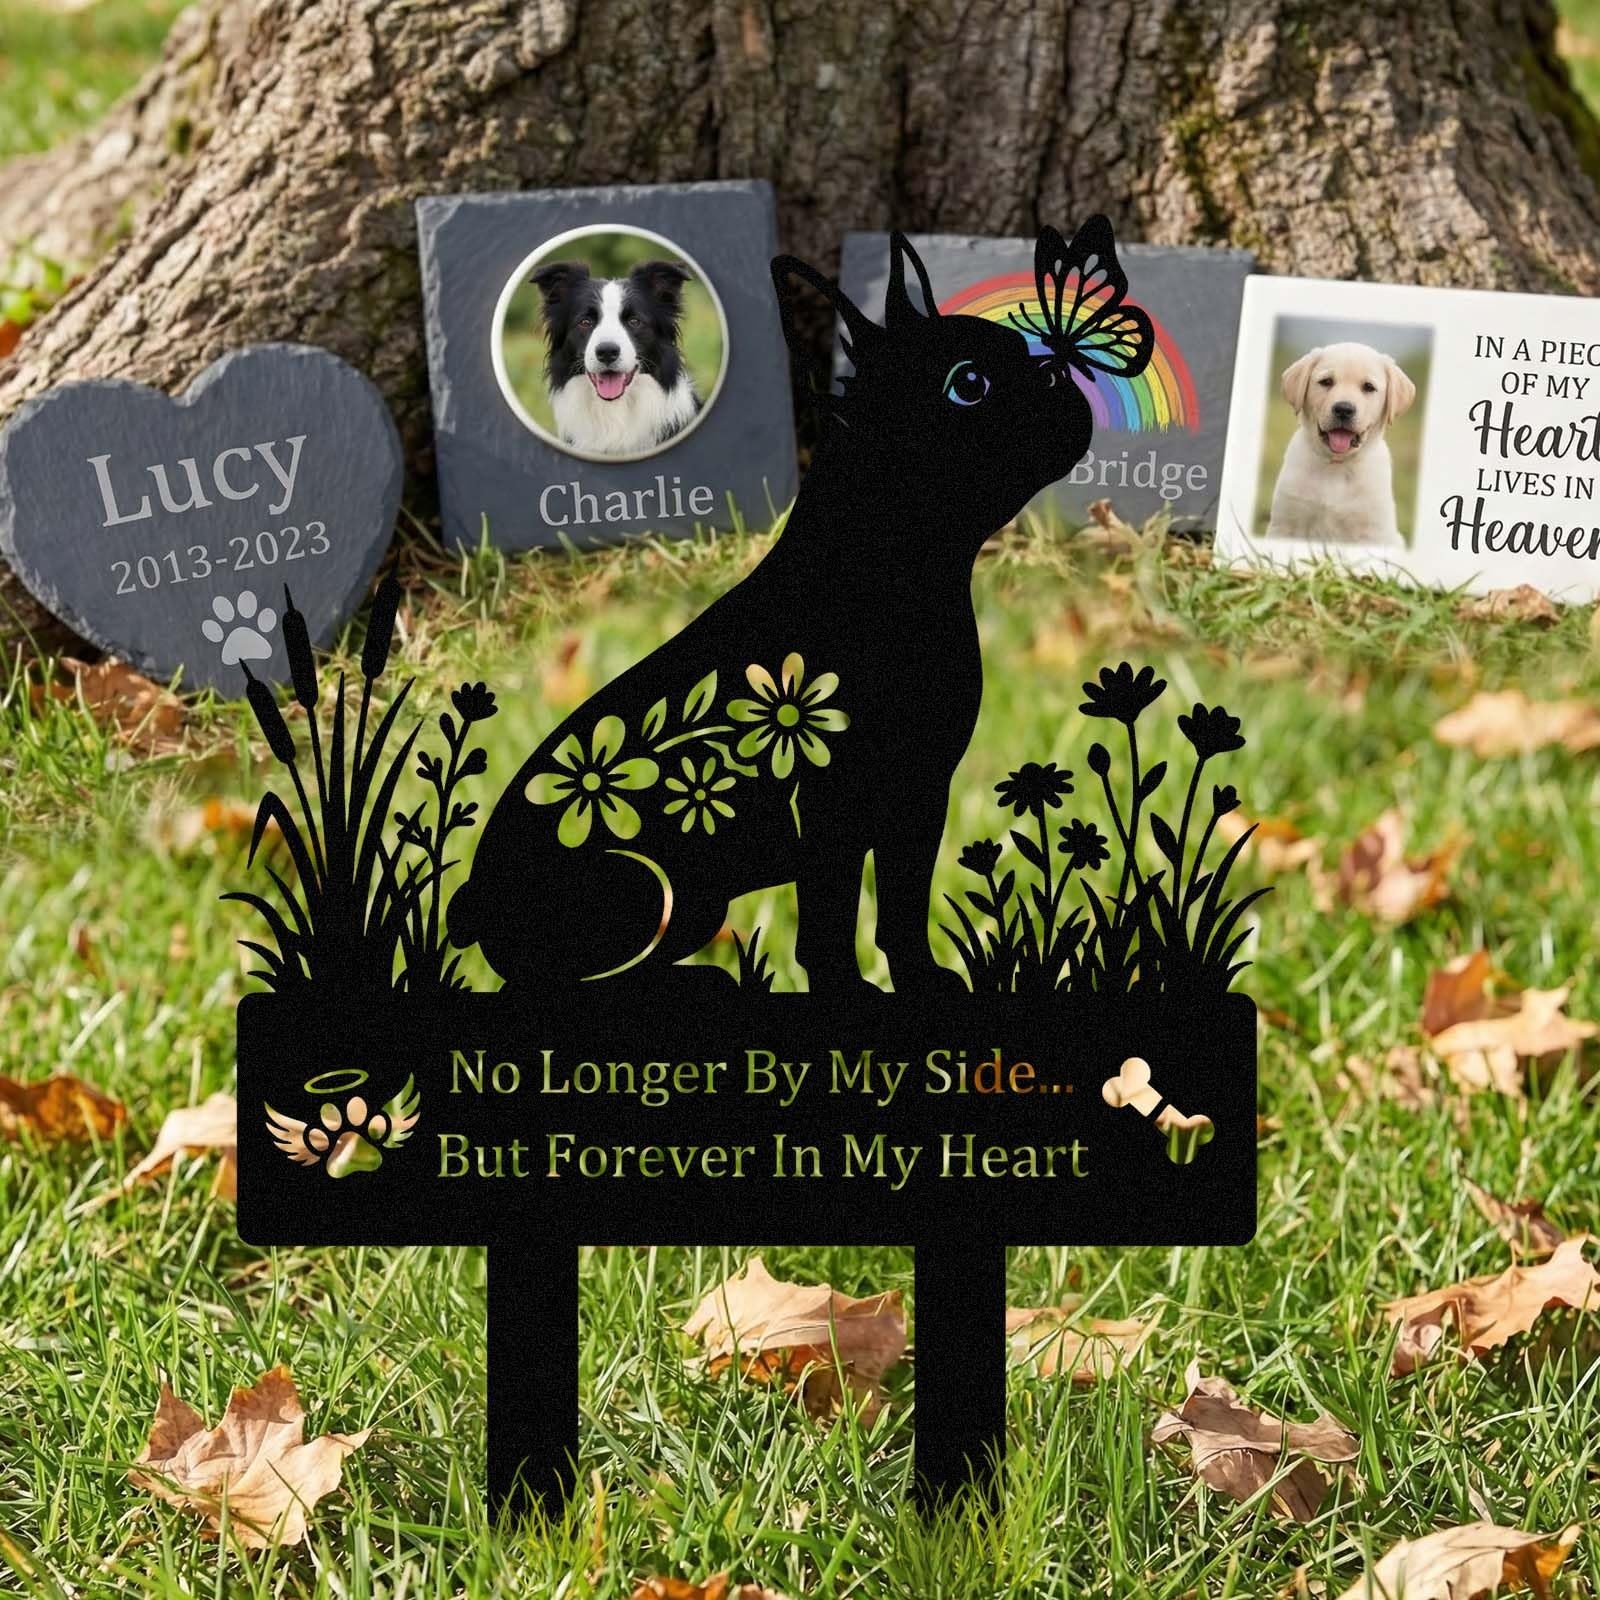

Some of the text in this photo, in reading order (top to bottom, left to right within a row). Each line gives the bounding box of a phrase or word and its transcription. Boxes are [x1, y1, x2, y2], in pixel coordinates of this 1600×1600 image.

[1474, 335, 1505, 359] IN
[1511, 338, 1532, 362] A
[1501, 371, 1590, 400] OF MY
[86, 434, 308, 528] Lucy
[1068, 449, 1208, 500] Bridge
[1476, 468, 1595, 500] LIVES IN
[539, 475, 715, 526] Charlie
[110, 521, 331, 595] 2013-2023
[450, 1047, 1074, 1107] No Longer By My Side...
[436, 1133, 1090, 1191] But Forever In My Heart
